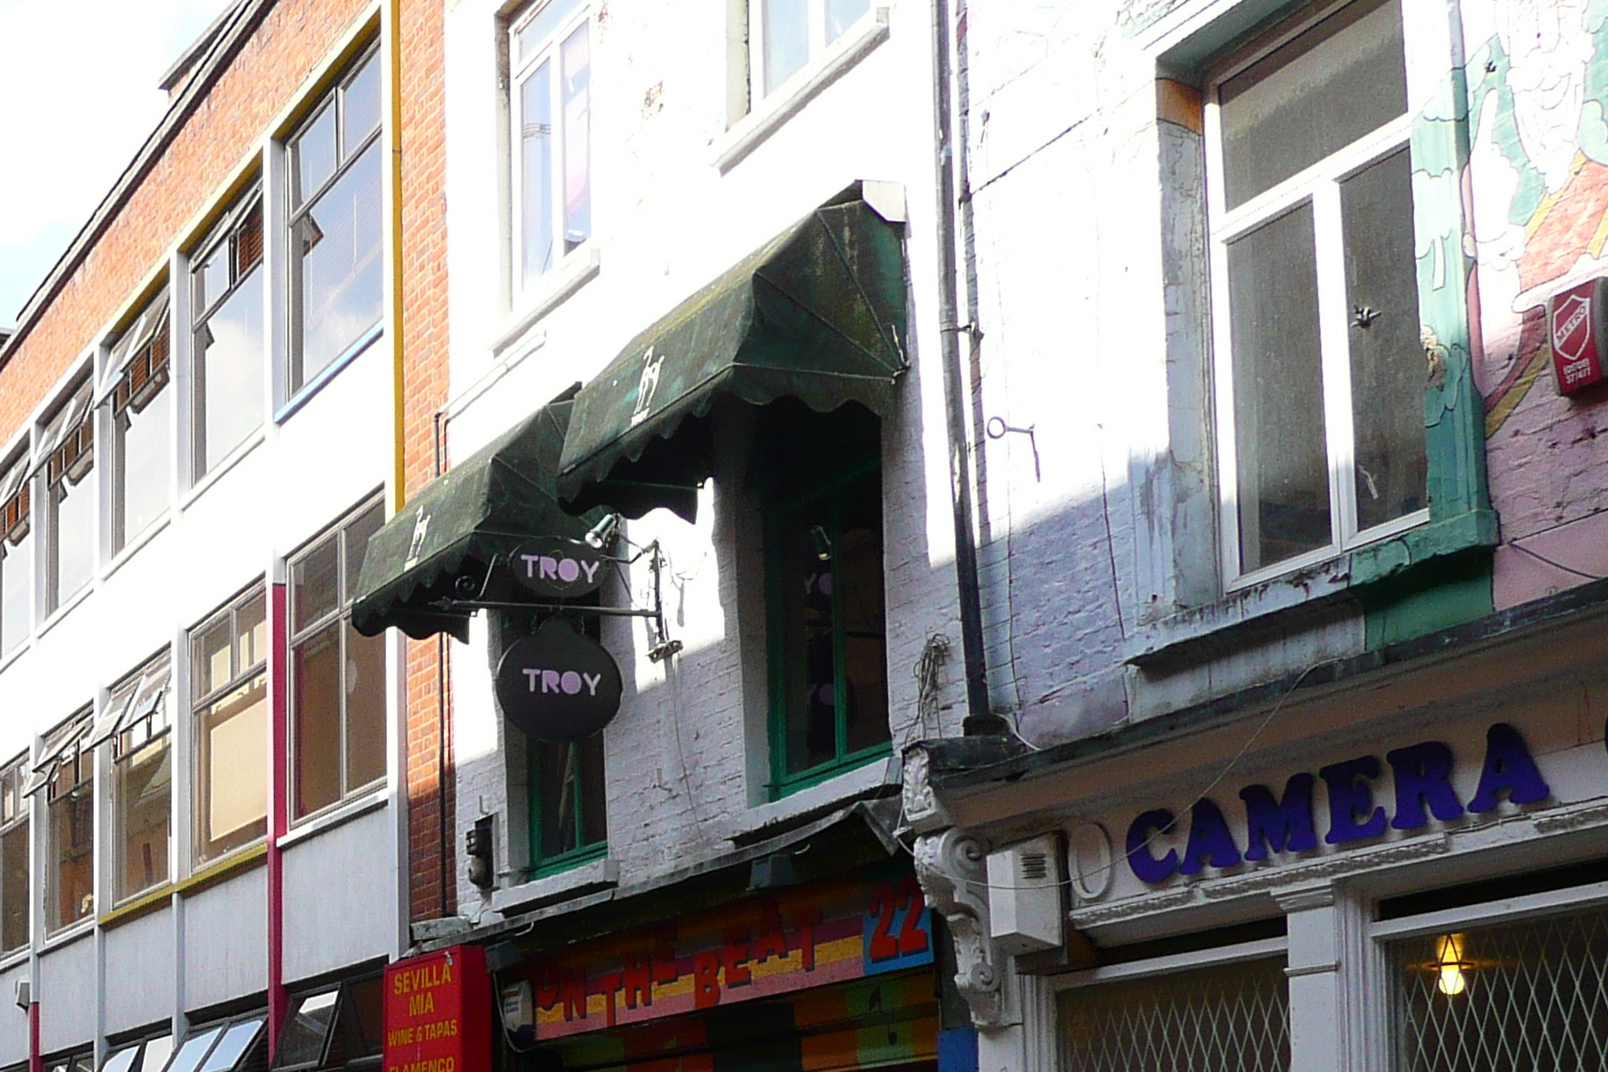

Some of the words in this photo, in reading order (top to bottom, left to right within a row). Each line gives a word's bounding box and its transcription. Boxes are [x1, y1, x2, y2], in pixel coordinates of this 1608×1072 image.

[1556, 306, 1586, 343] METRO
[521, 554, 600, 584] TROY
[522, 668, 601, 696] TROY
[1125, 723, 1550, 884] CAMERA
[868, 875, 930, 964] 22
[394, 963, 452, 995] SEVILLA
[534, 962, 587, 1022] ON
[596, 922, 679, 1028] THE
[694, 899, 824, 1010] BEAT
[409, 991, 435, 1017] MIA
[388, 1027, 414, 1048] WINE
[416, 1025, 423, 1043] &
[424, 1019, 458, 1041] TAPAS
